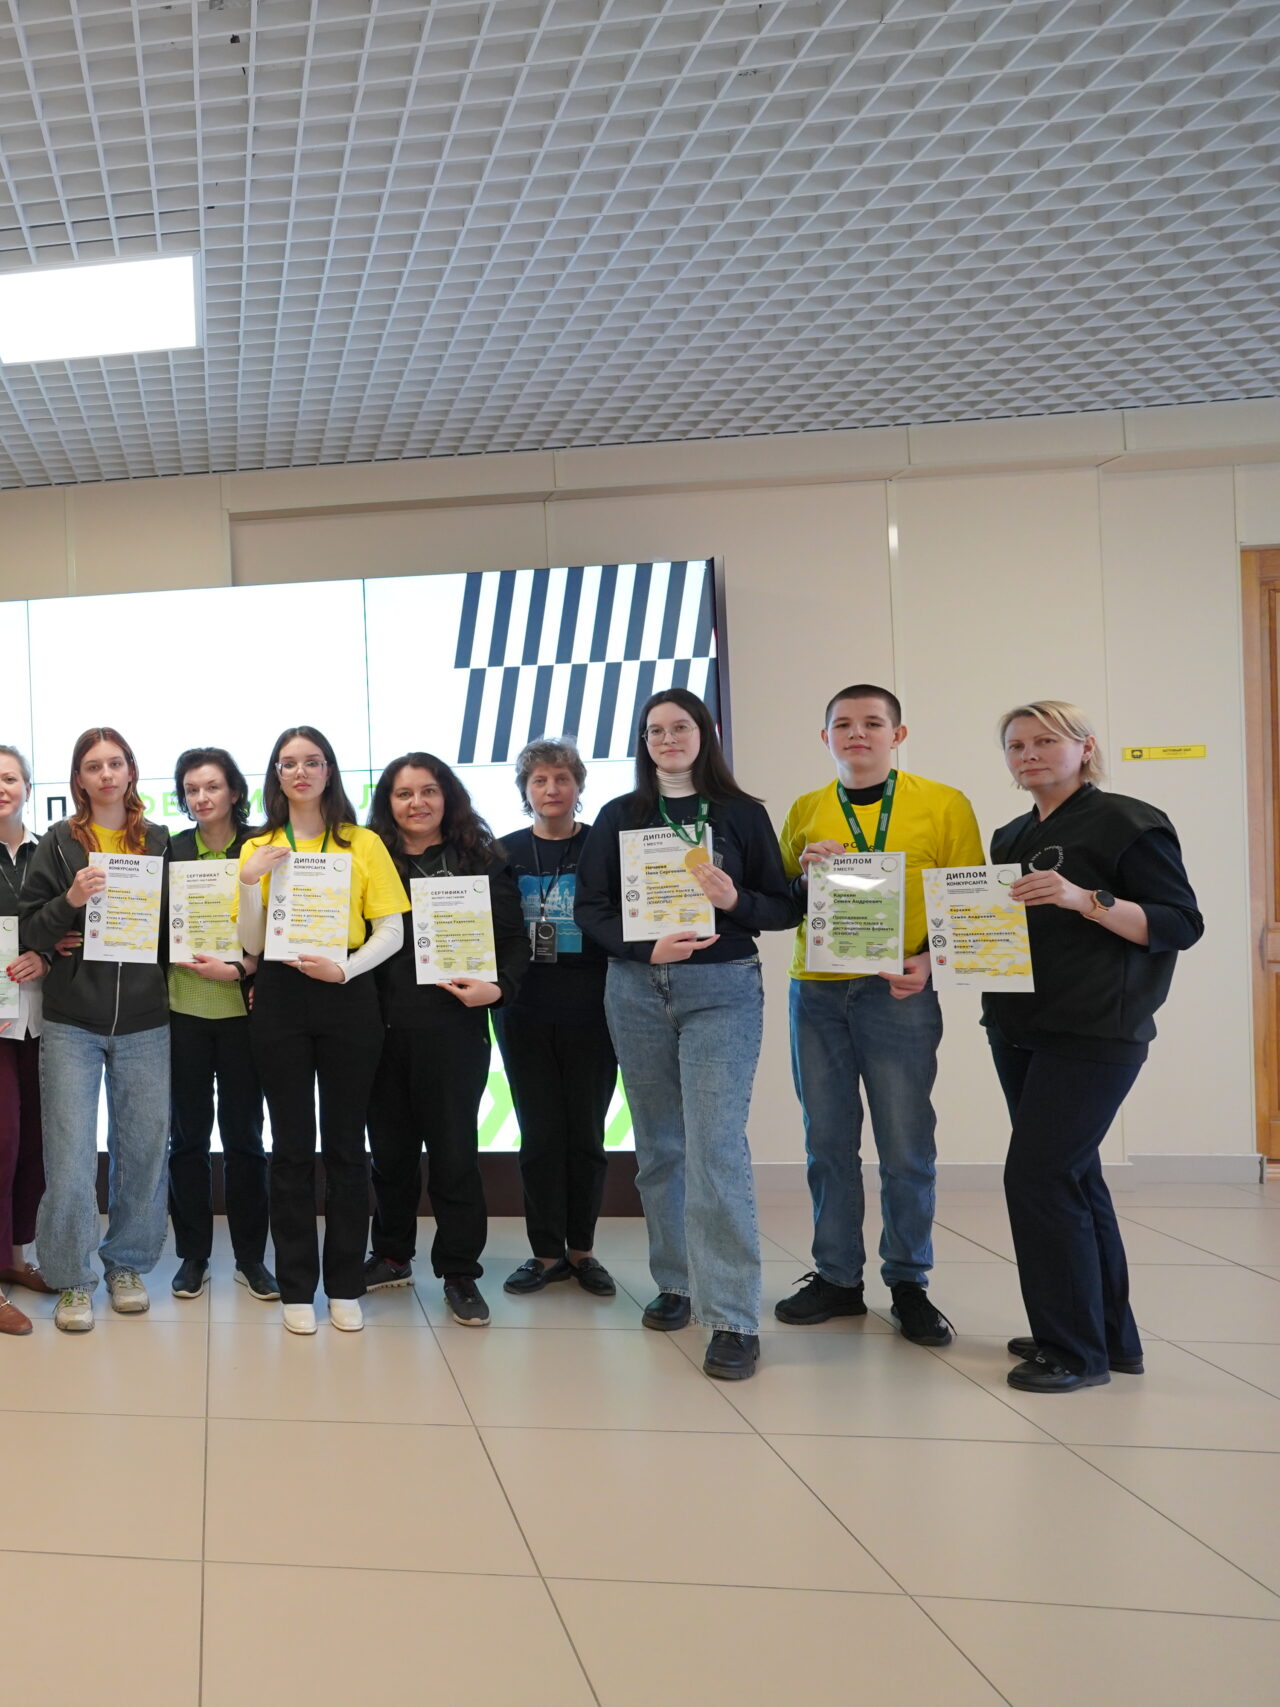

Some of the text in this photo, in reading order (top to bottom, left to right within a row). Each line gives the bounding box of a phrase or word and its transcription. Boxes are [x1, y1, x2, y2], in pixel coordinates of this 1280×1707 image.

[643, 833, 679, 841] ДИПЛОМ
[109, 858, 140, 866] ДИПЛОМ
[833, 858, 872, 866] ДИПЛОМ
[946, 871, 987, 880] ДИПЛОМ
